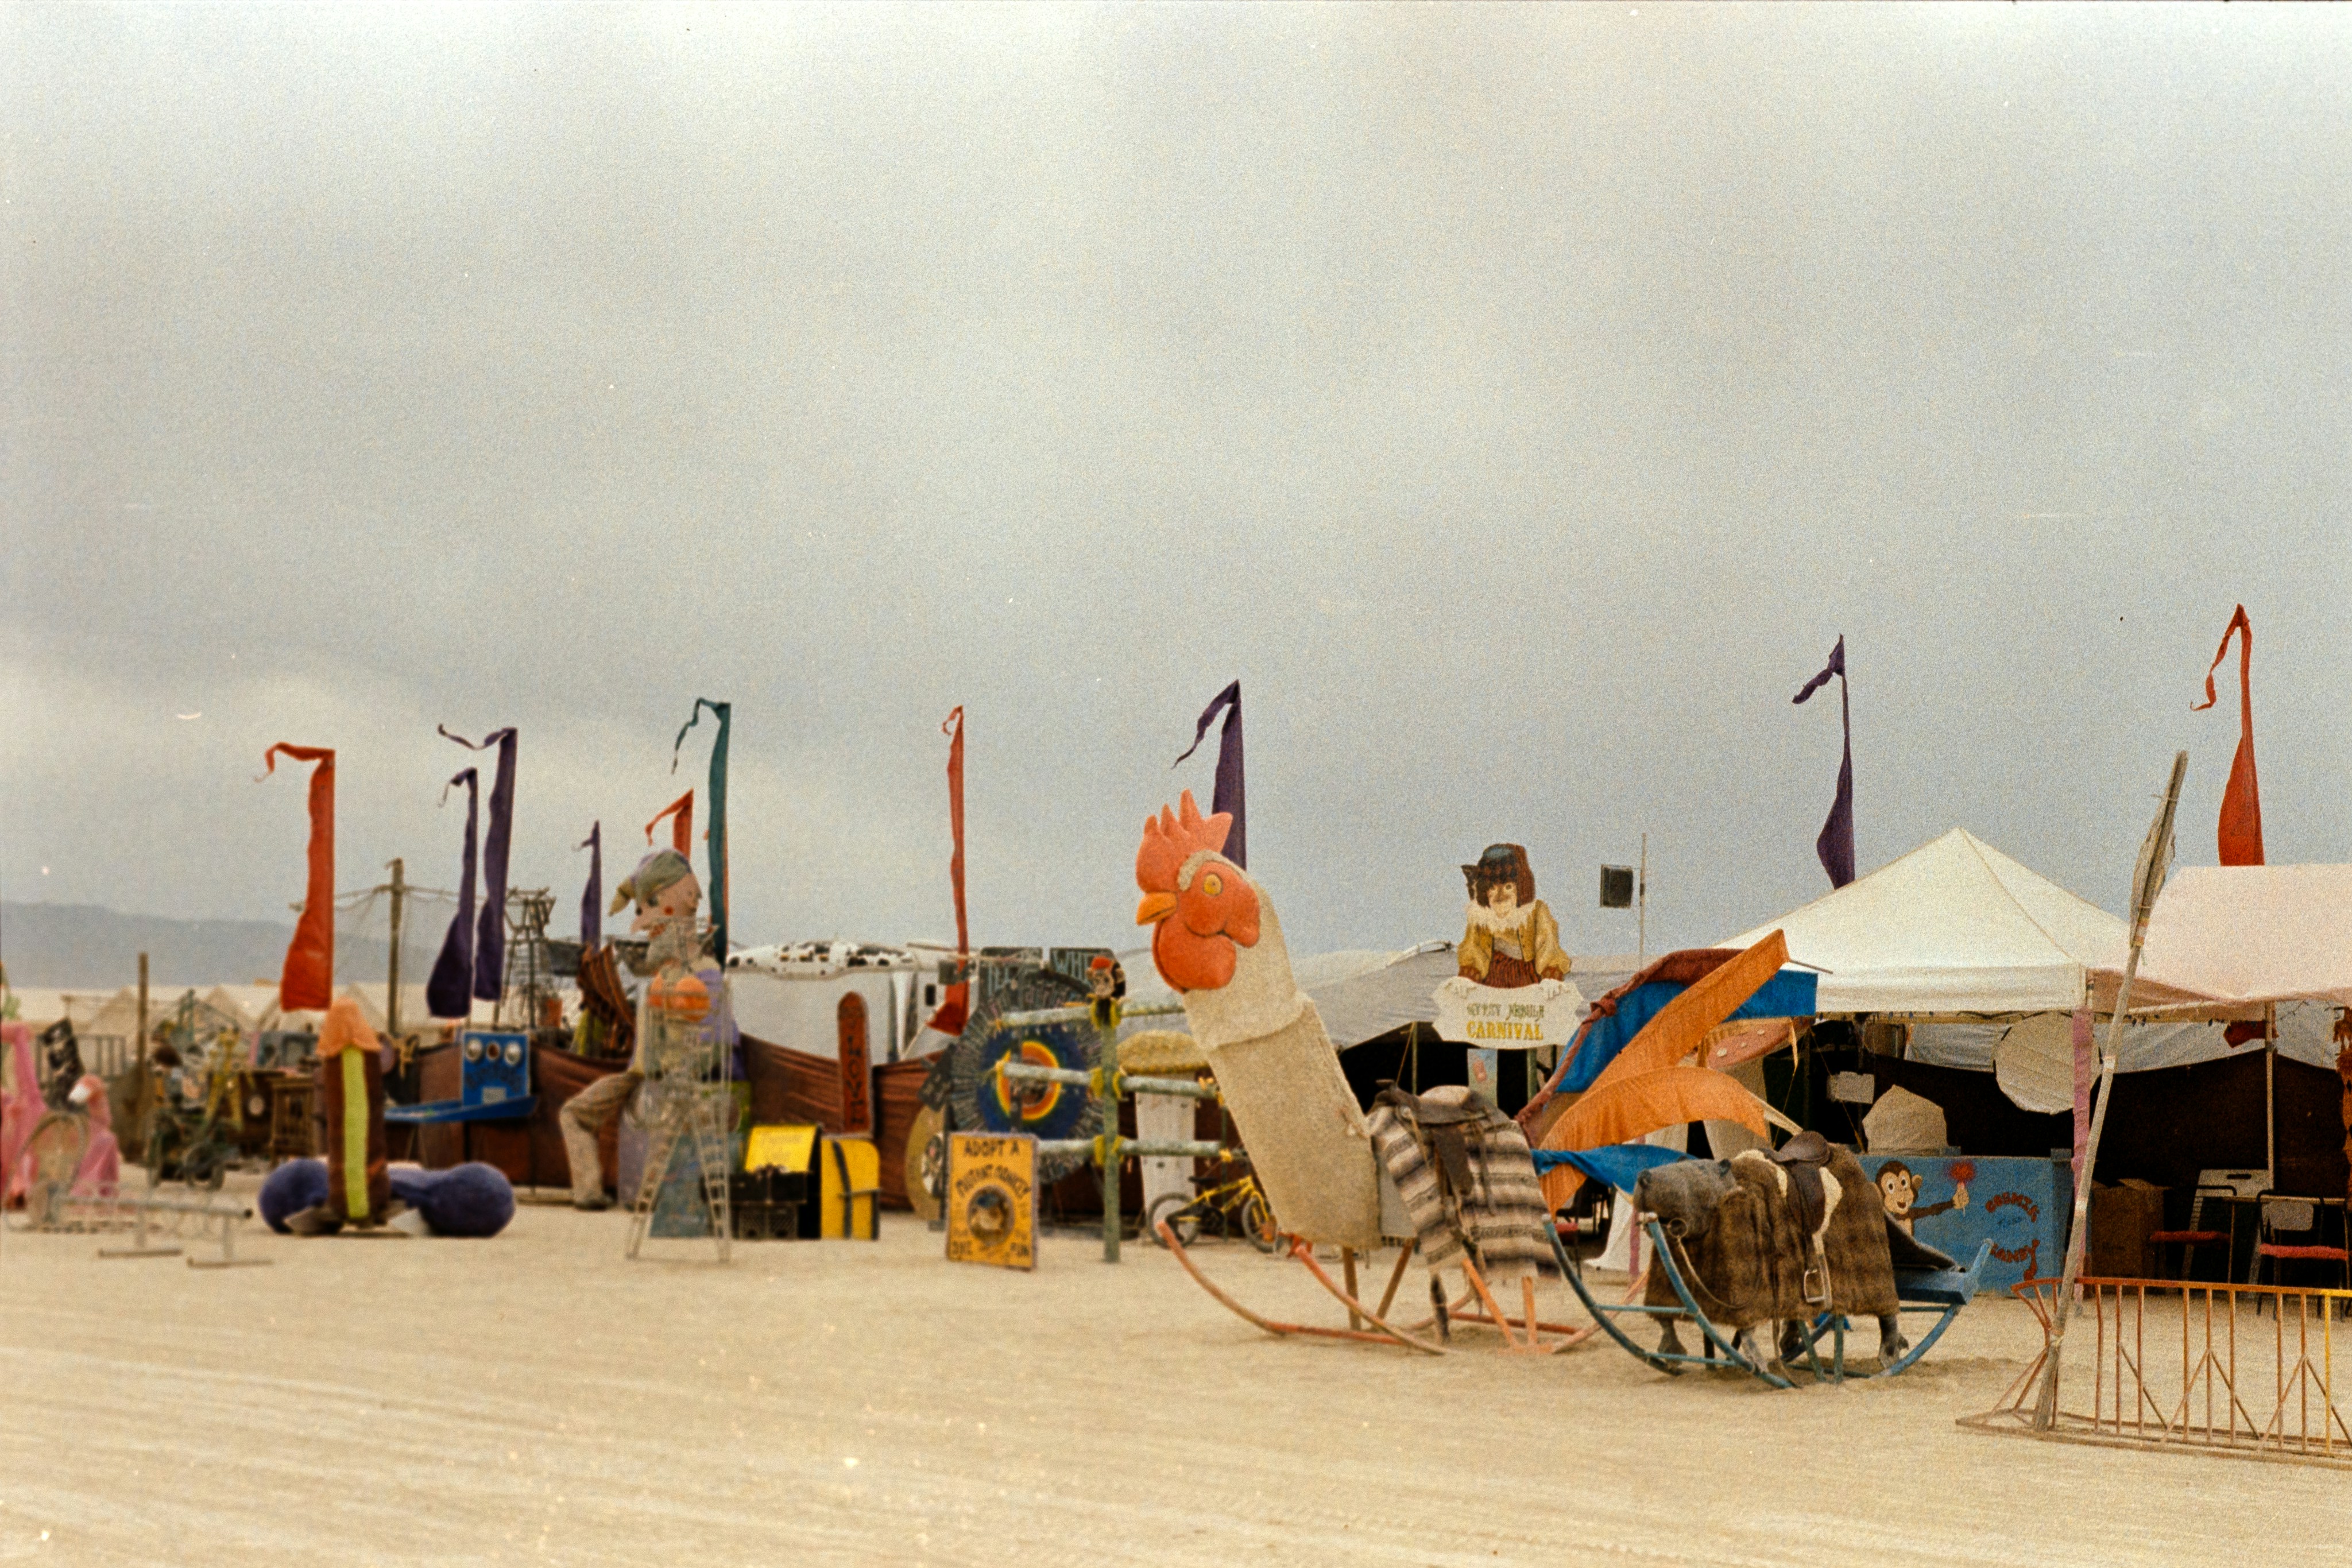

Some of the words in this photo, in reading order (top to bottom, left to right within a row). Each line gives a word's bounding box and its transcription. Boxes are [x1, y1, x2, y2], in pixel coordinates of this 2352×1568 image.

[1466, 1020, 1544, 1040] CARNIVAL
[964, 1140, 1005, 1157] ADOPT
[1010, 1140, 1020, 1156] A
[1986, 1191, 2040, 1222] COSMIC
